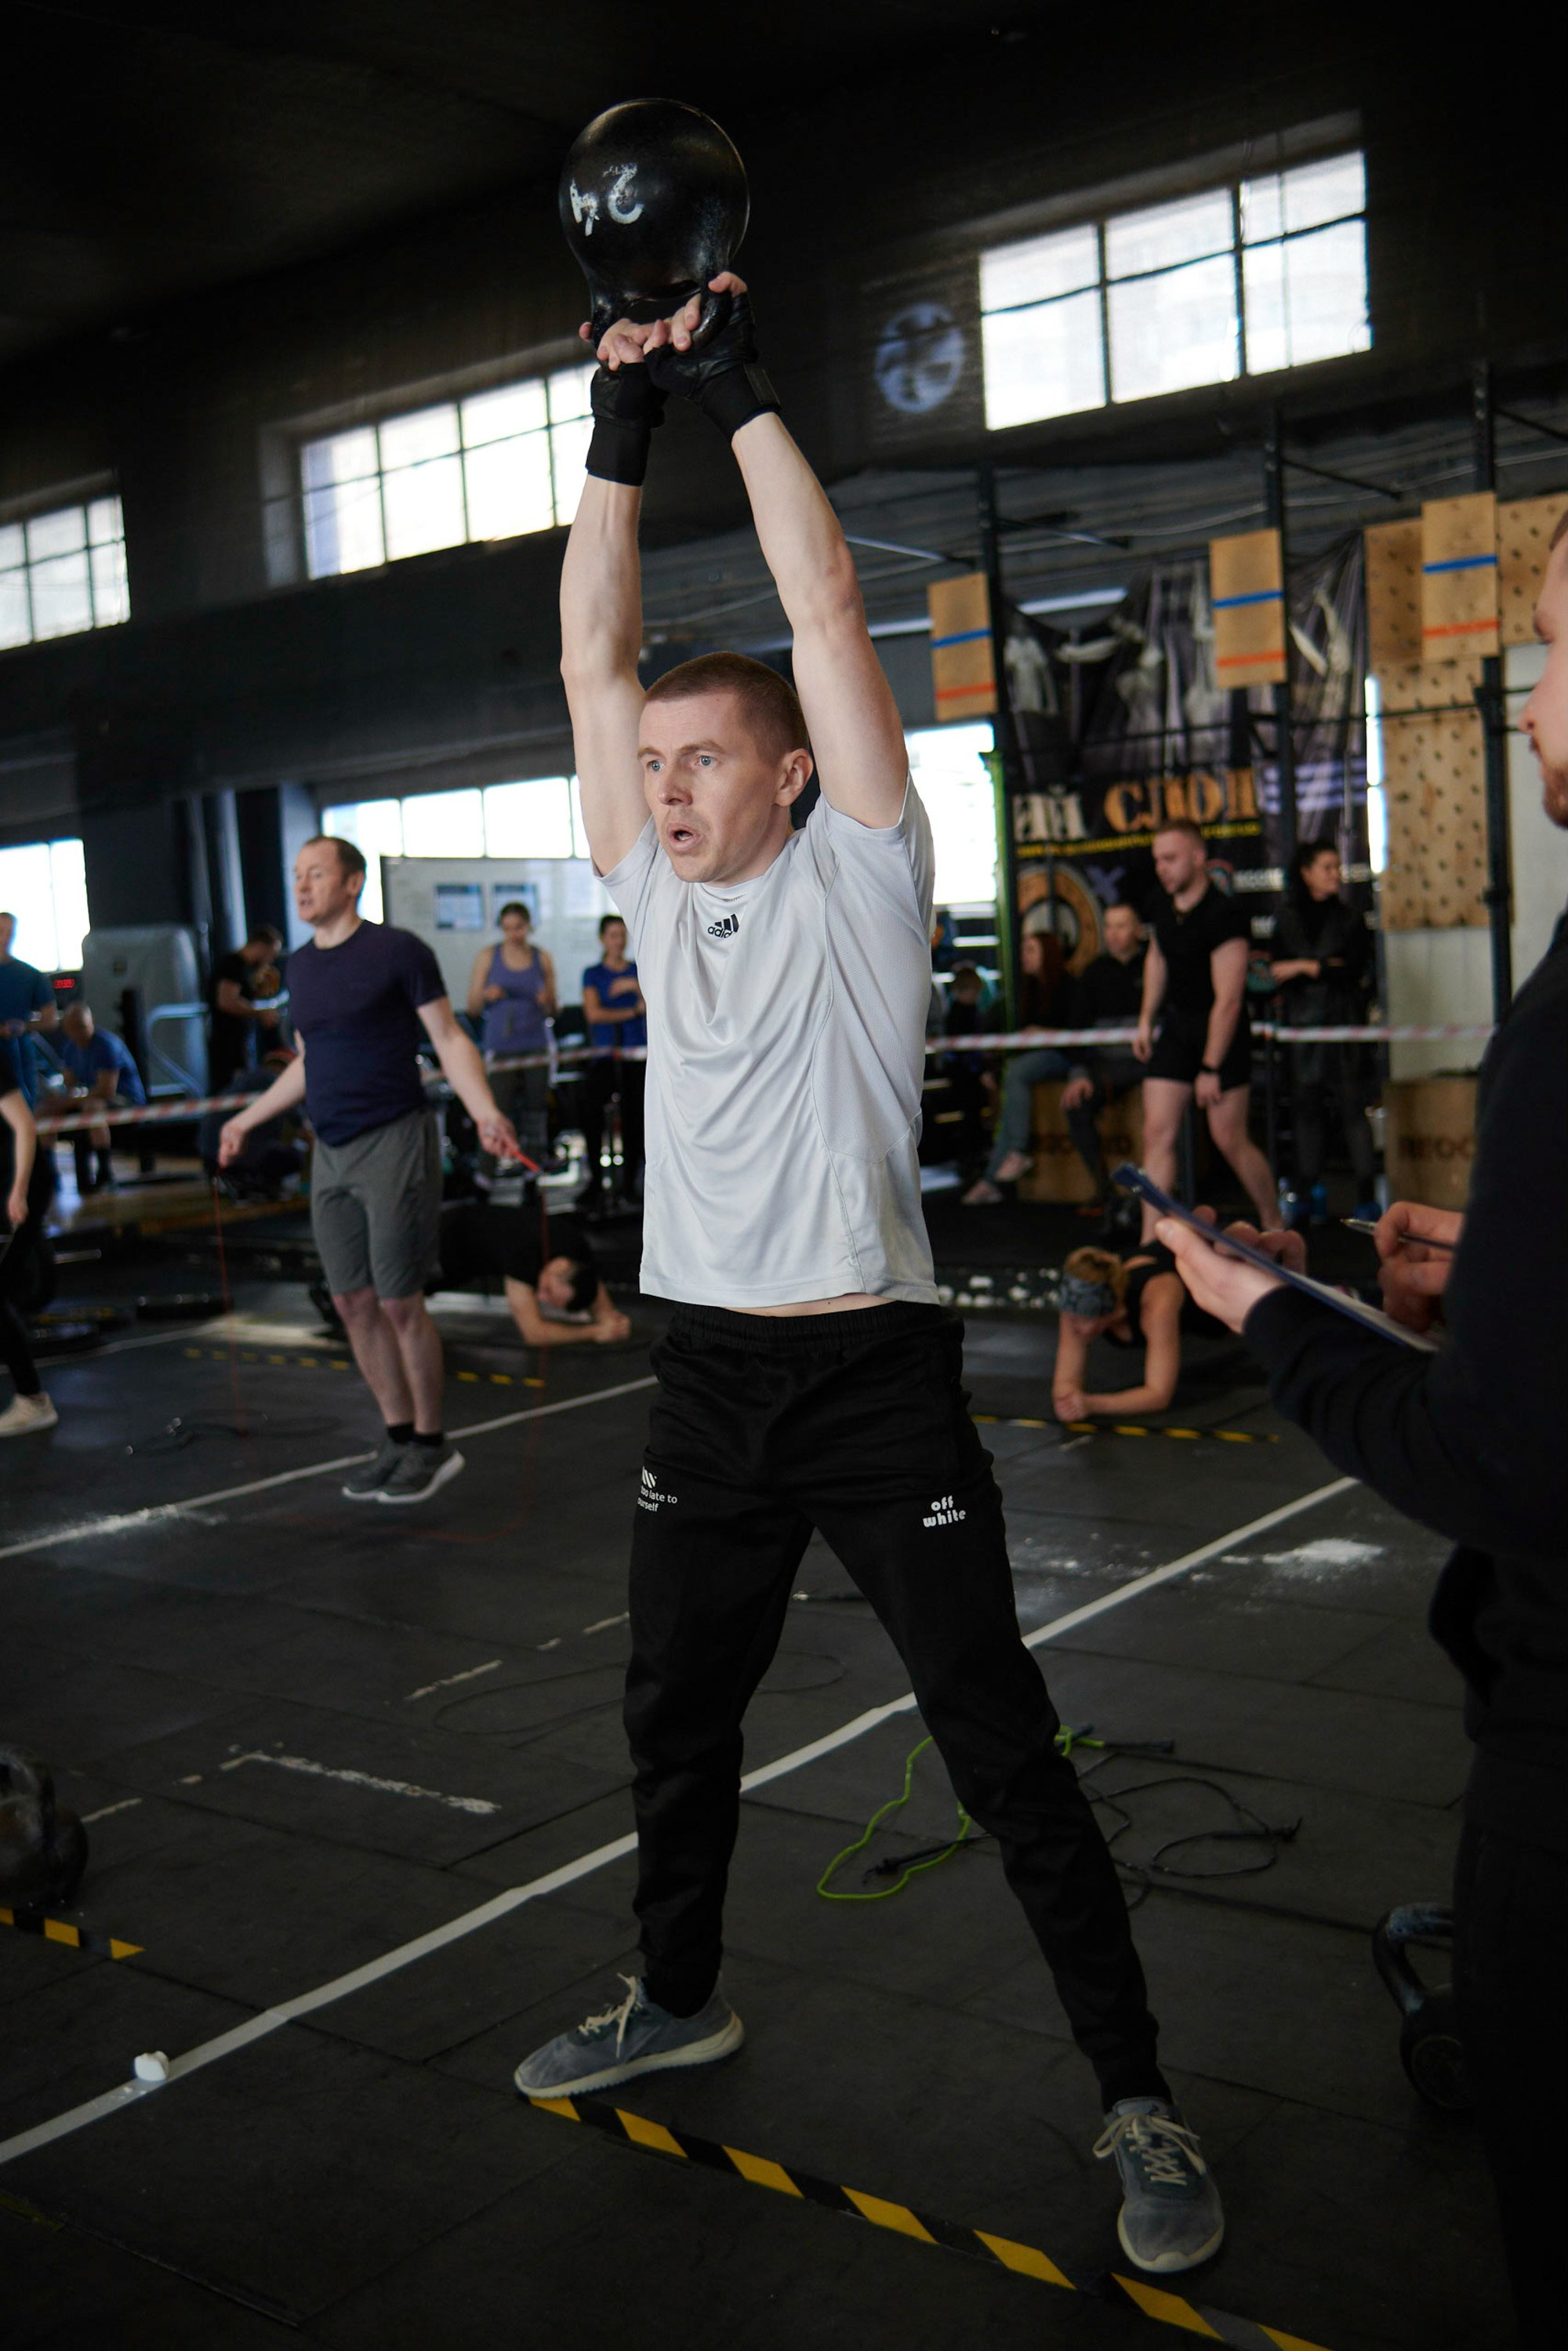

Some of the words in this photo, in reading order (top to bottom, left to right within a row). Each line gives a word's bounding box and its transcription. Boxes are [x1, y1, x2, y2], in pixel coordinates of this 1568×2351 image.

[707, 926, 733, 938] adid
[649, 1490, 666, 1502] late
[667, 1495, 678, 1504] to
[931, 1495, 954, 1511] off
[922, 1509, 967, 1528] white
